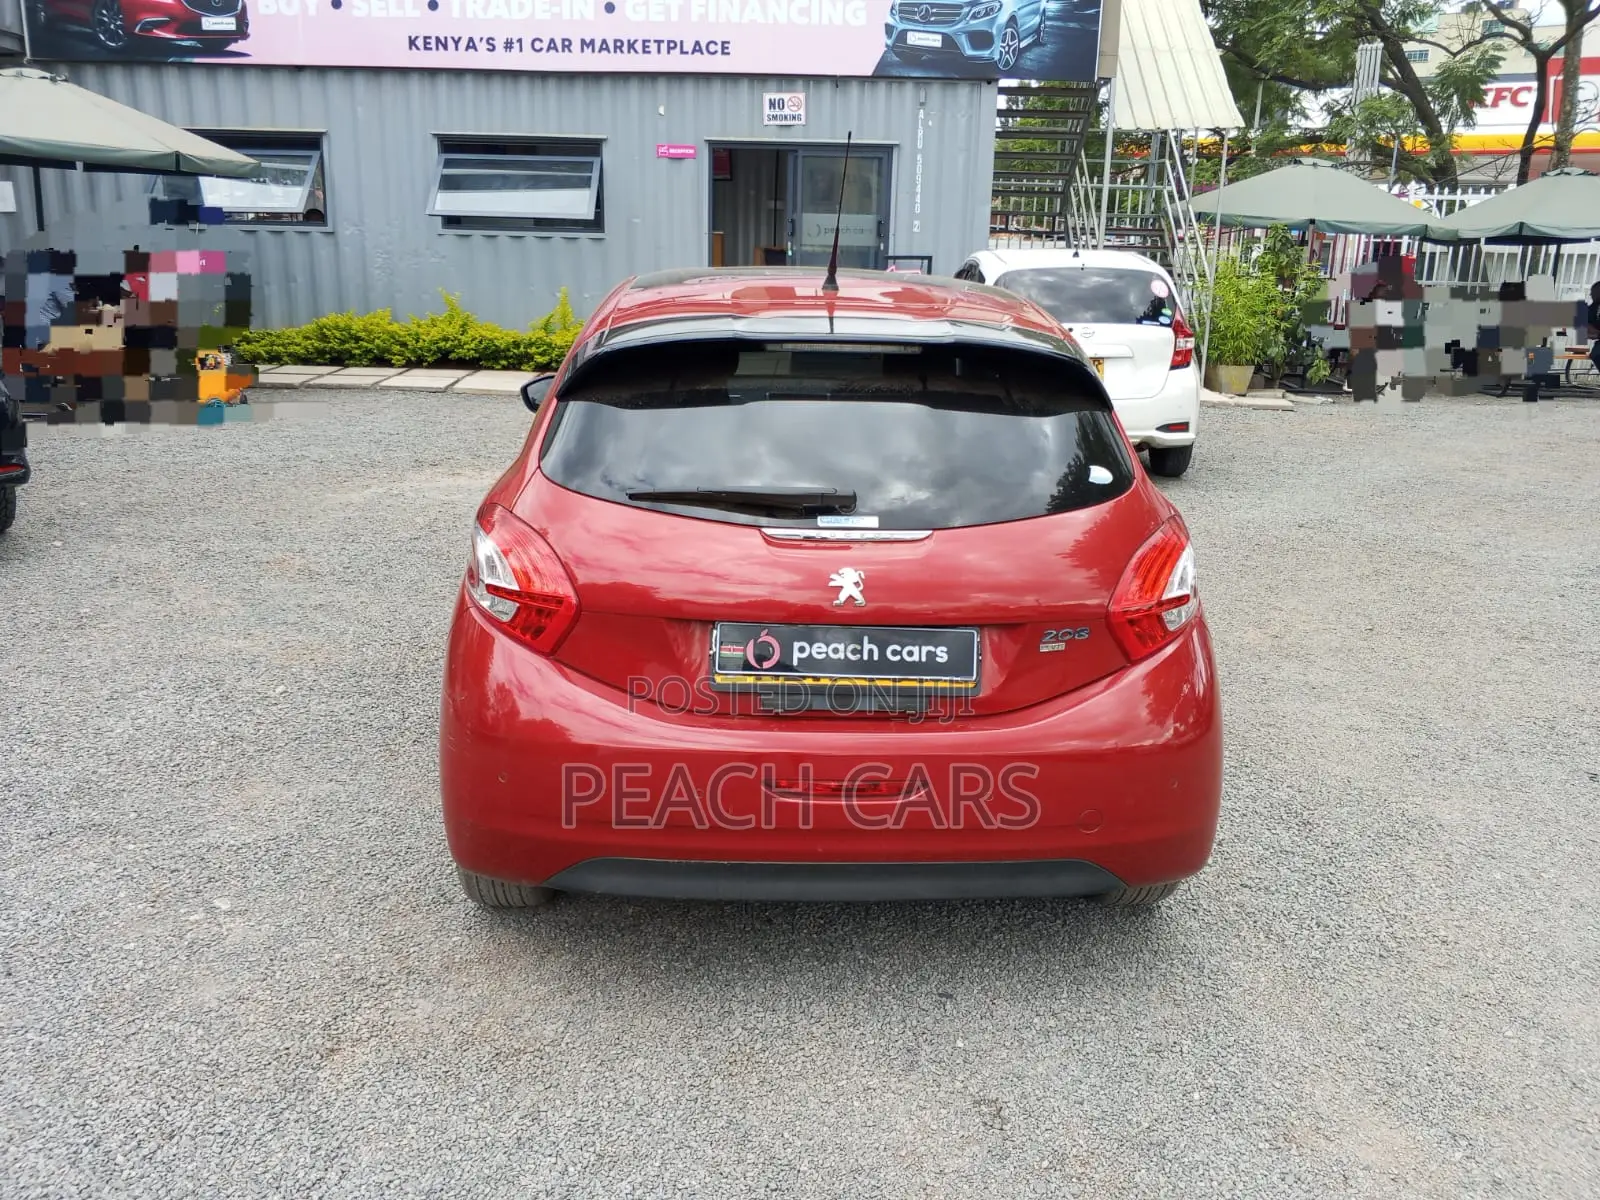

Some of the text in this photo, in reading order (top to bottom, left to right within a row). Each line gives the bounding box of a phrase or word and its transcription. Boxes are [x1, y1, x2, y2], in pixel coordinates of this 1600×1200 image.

[257, 0, 867, 26] BUY SELL TRADE-IN GET FINANCING
[502, 38, 523, 53] #1
[530, 37, 573, 54] CAR
[580, 38, 731, 56] MARKETPLACE
[768, 97, 785, 111] NO
[766, 113, 803, 122] SMOKING
[792, 635, 949, 666] peach cars
